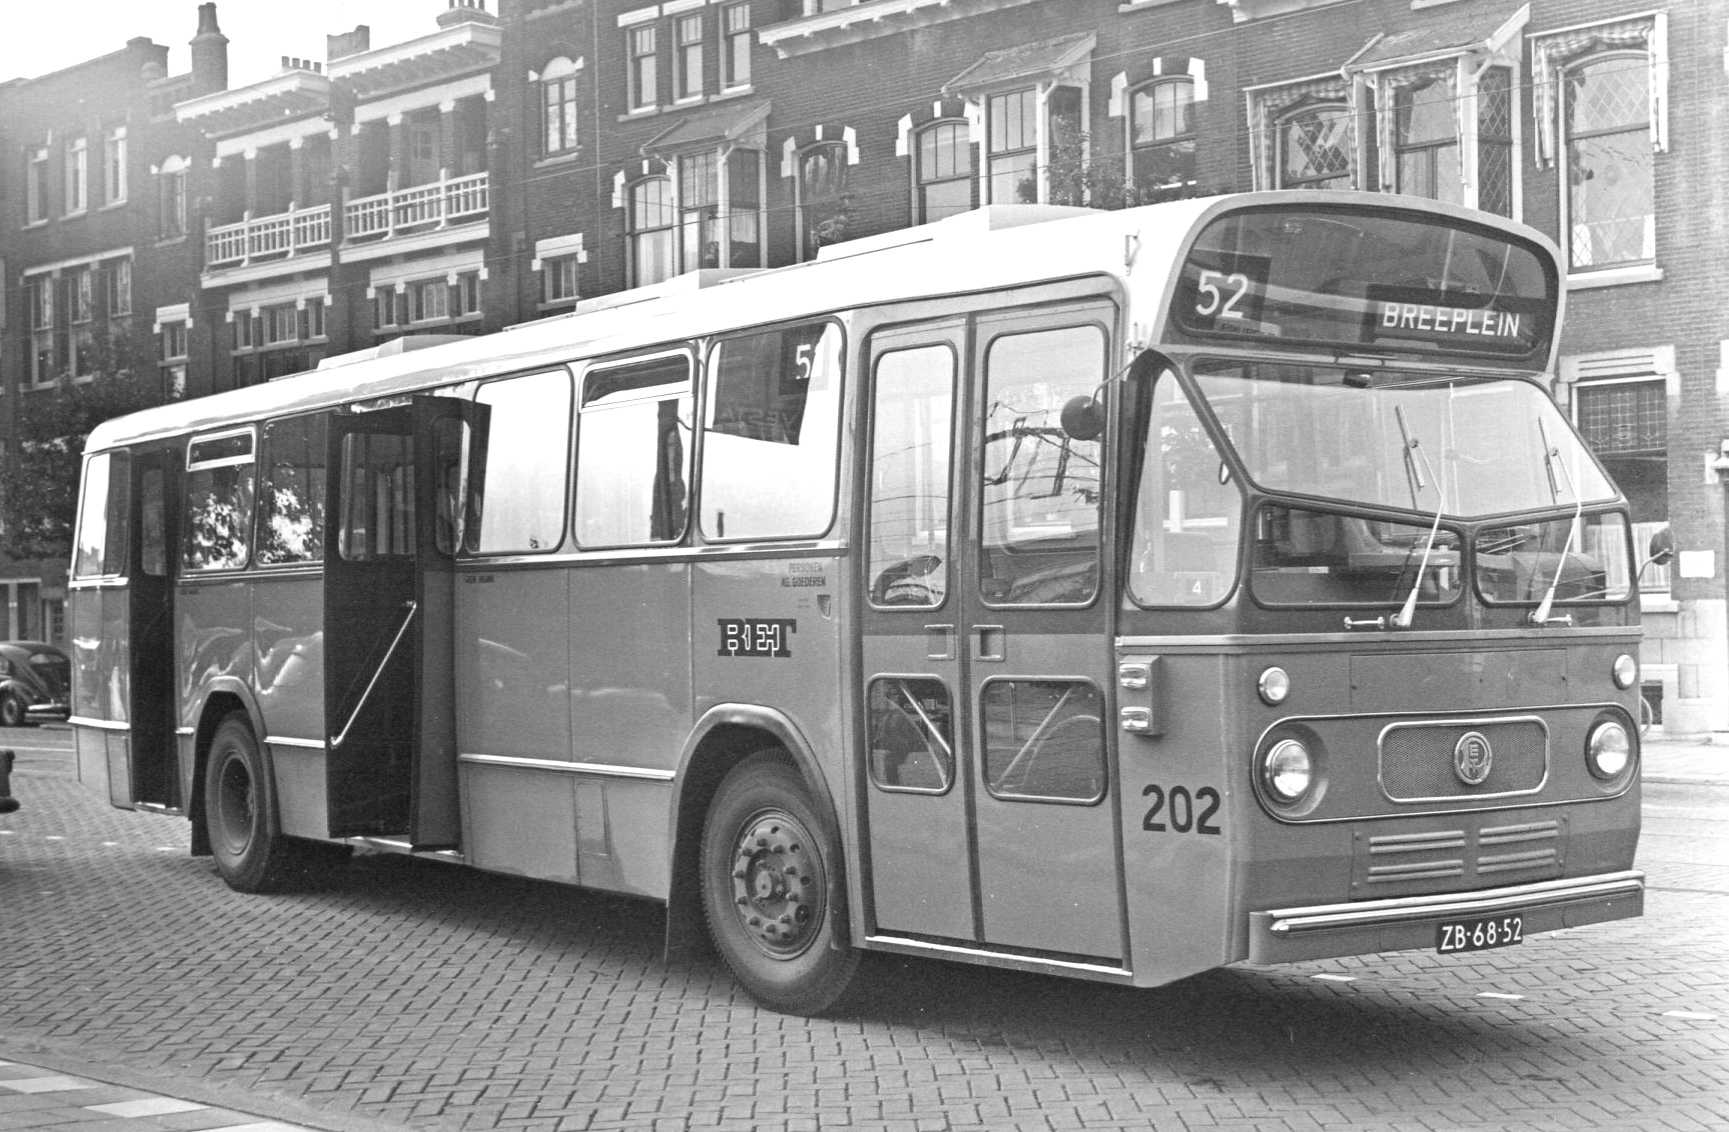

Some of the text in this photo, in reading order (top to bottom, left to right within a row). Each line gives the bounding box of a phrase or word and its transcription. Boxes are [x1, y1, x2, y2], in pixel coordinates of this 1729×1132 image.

[1195, 270, 1248, 319] 52
[1383, 302, 1520, 337] BREEPLEIN
[718, 618, 797, 657] RET
[1142, 784, 1222, 835] 202
